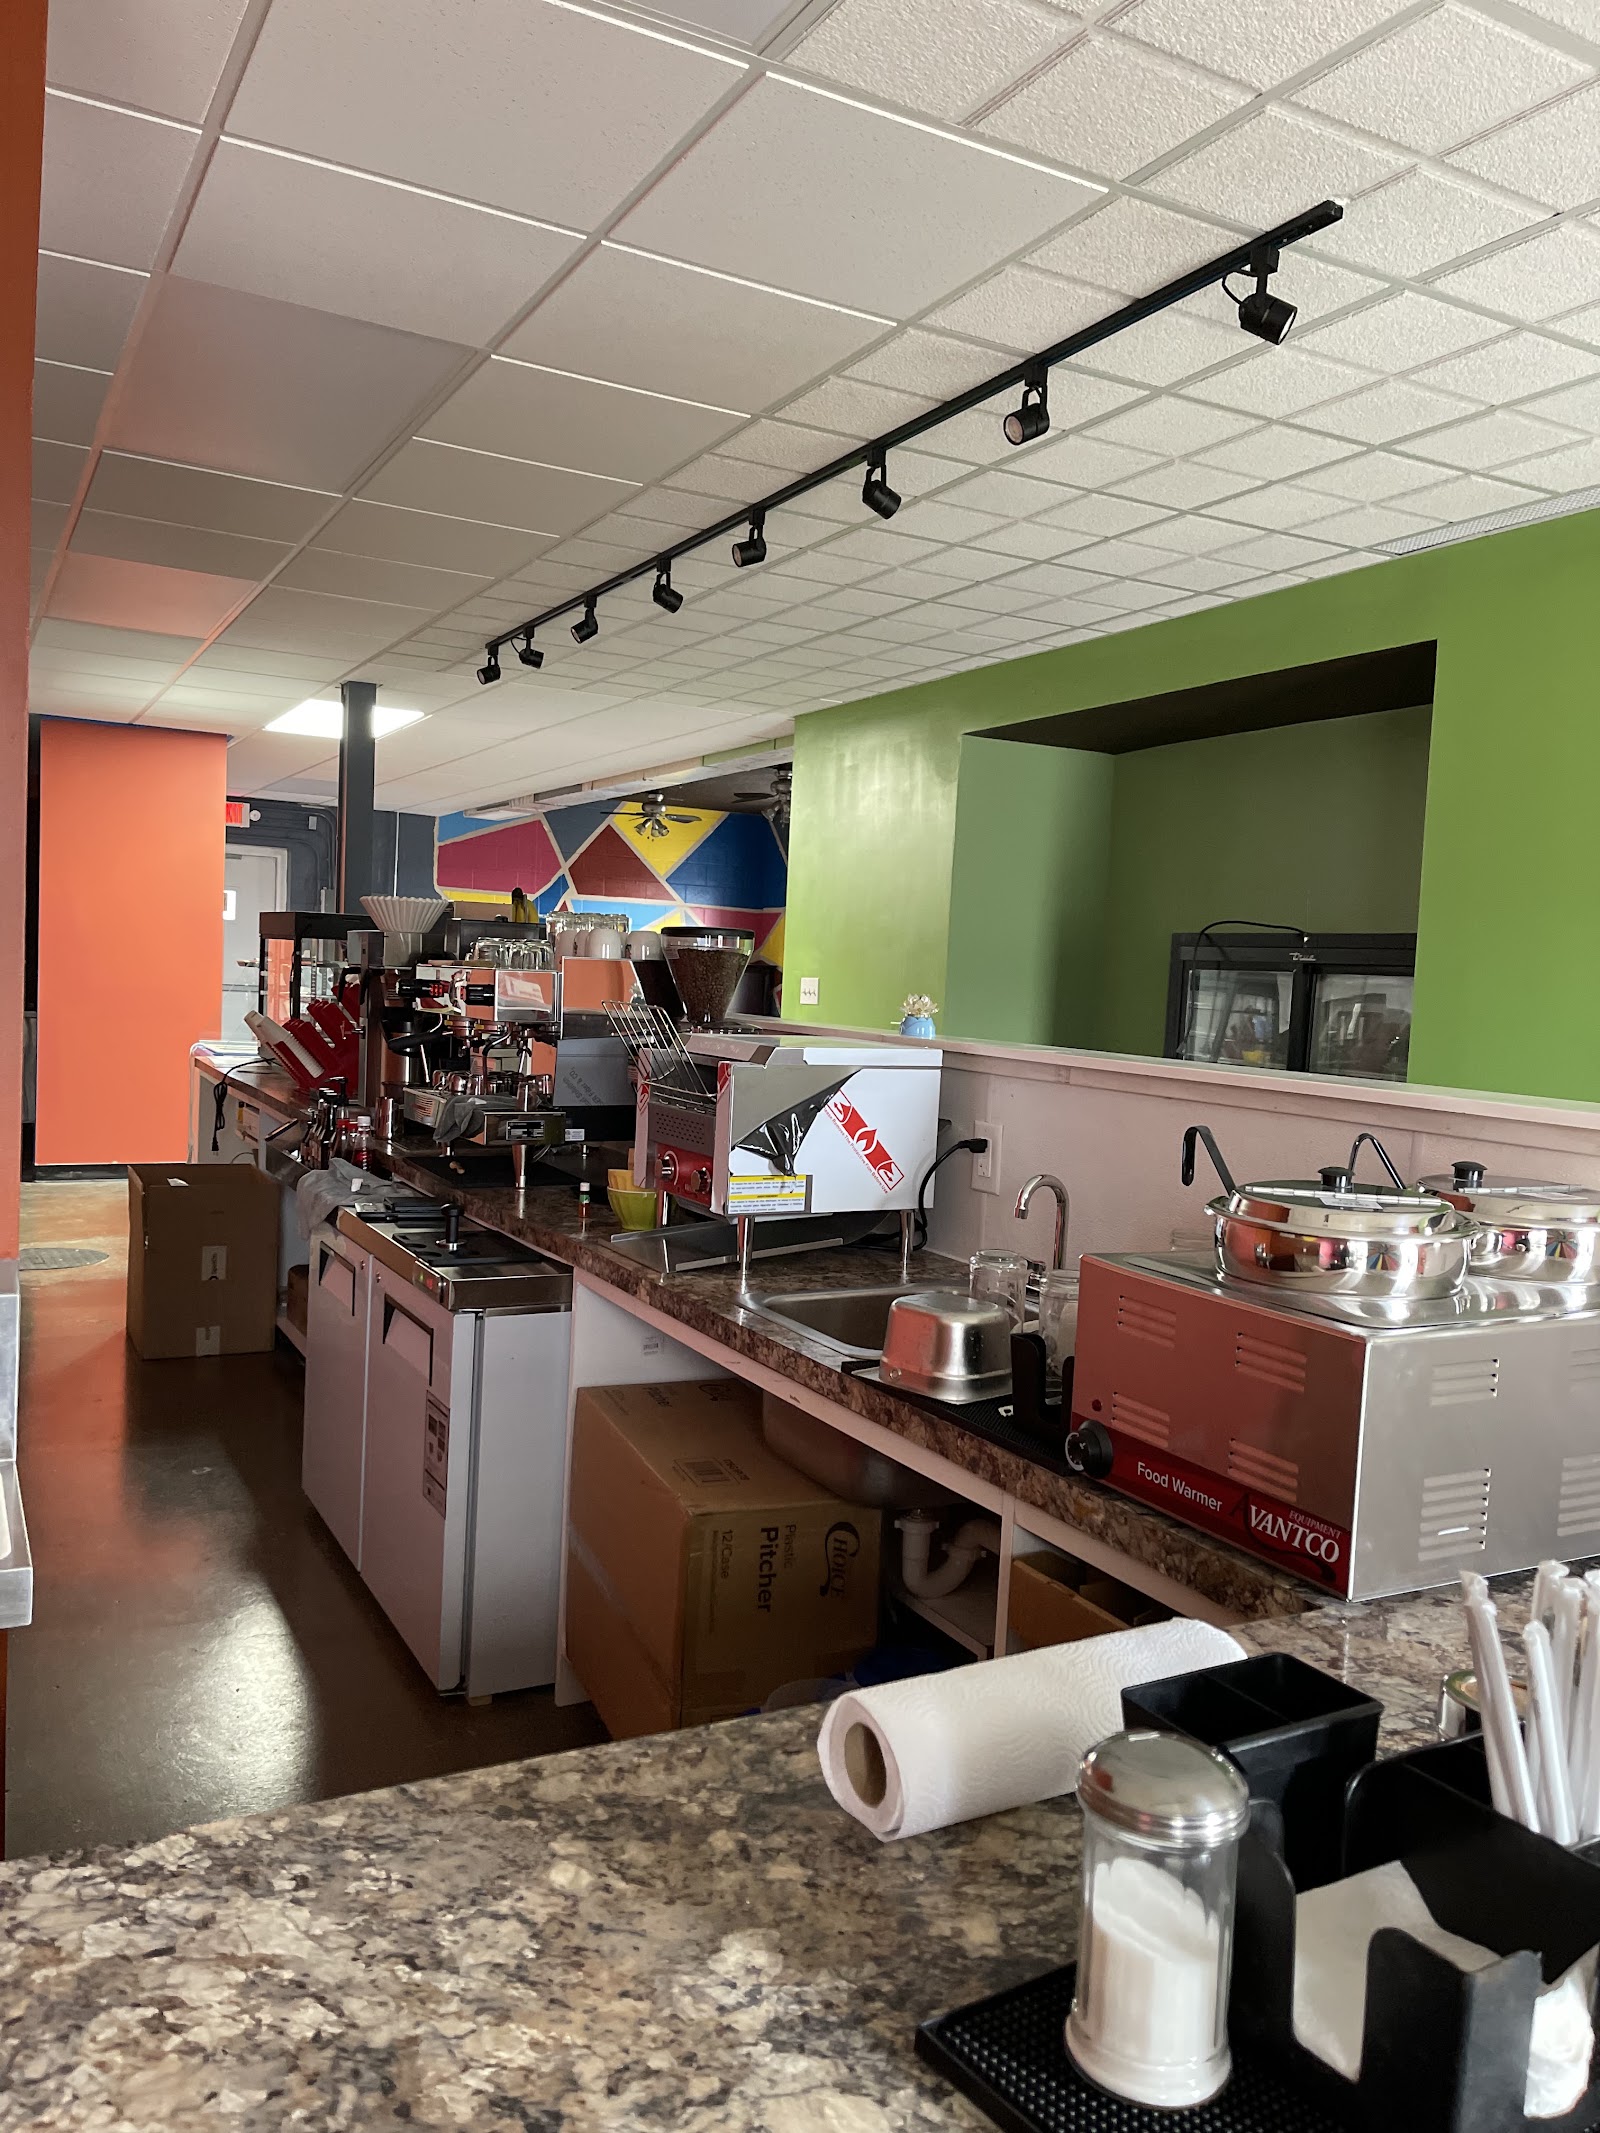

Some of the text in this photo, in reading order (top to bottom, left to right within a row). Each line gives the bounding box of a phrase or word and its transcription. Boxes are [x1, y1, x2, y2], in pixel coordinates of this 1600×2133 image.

[831, 1118, 845, 1136] Remove
[849, 1142, 867, 1164] Protective
[871, 1171, 883, 1186] Before
[880, 1183, 889, 1194] Use
[1137, 1461, 1223, 1512] Food Warmer
[783, 1525, 797, 1569] Plastic
[1289, 1510, 1343, 1540] EQUIPMENT
[721, 1529, 733, 1579] 12/Case
[757, 1527, 779, 1613] Pitcher
[820, 1521, 860, 1599] CHOICE
